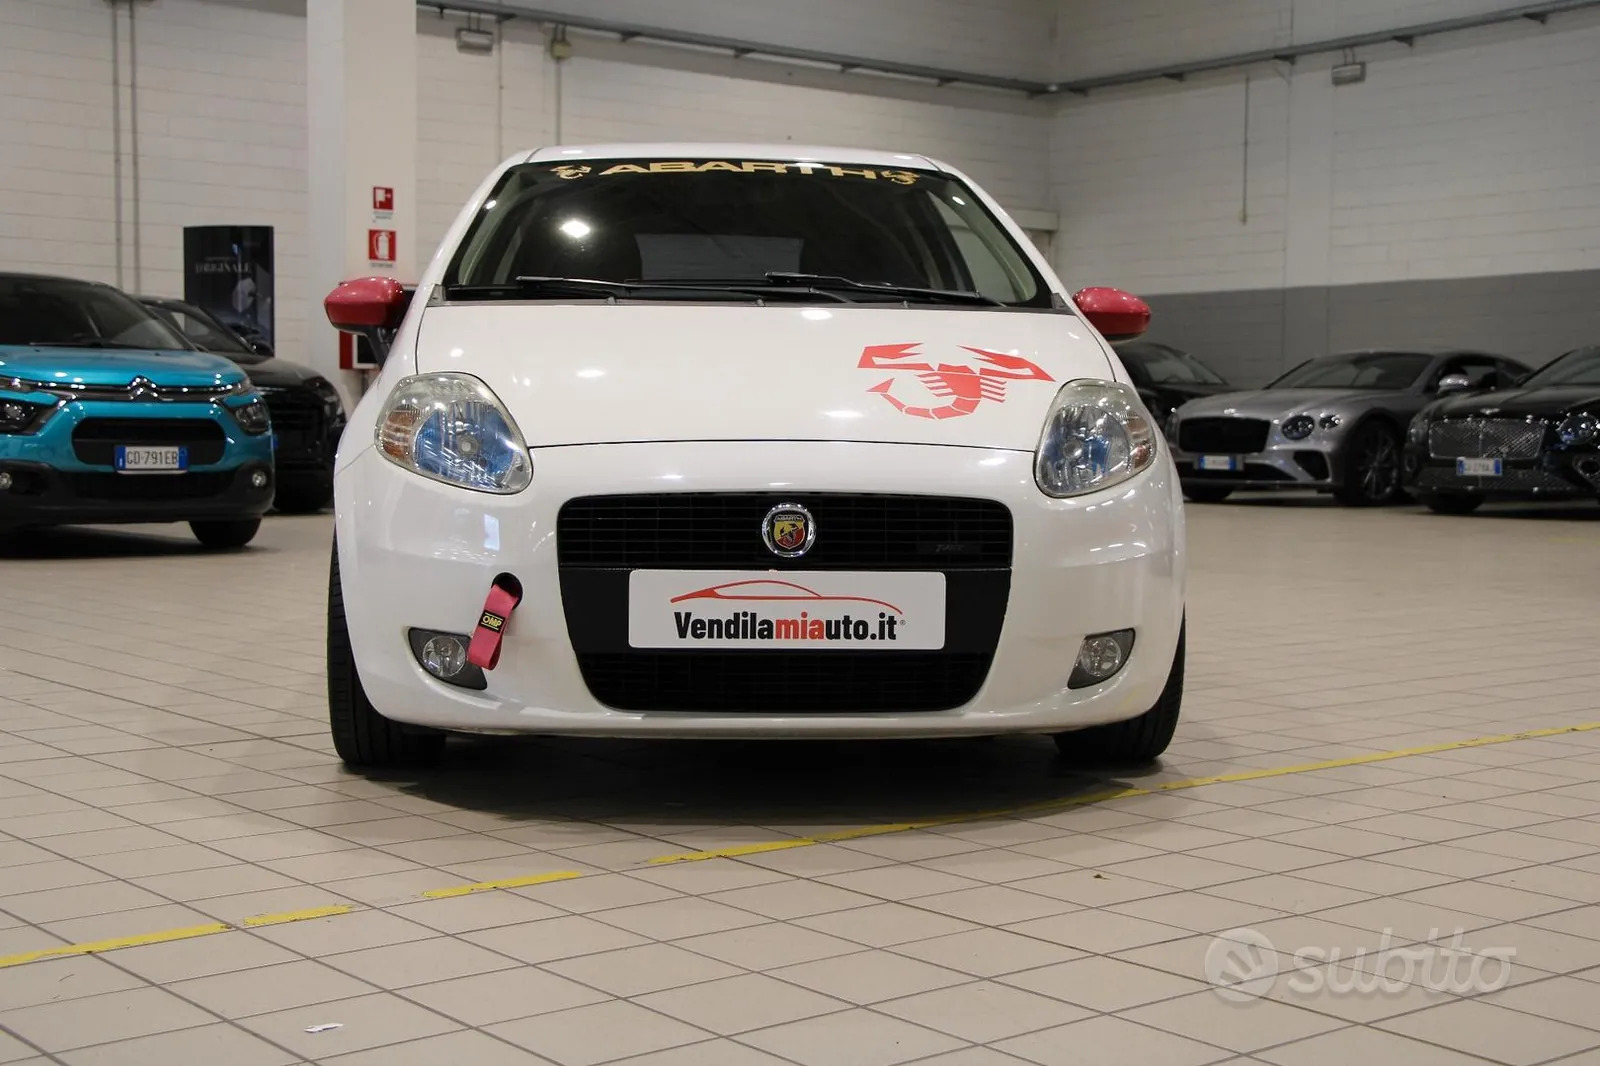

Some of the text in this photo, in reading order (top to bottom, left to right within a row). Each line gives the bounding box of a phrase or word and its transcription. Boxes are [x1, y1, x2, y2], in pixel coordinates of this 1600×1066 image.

[598, 160, 877, 180] ABARTH
[482, 615, 502, 628] OMP
[674, 611, 897, 640] Vendilamiauto.it
